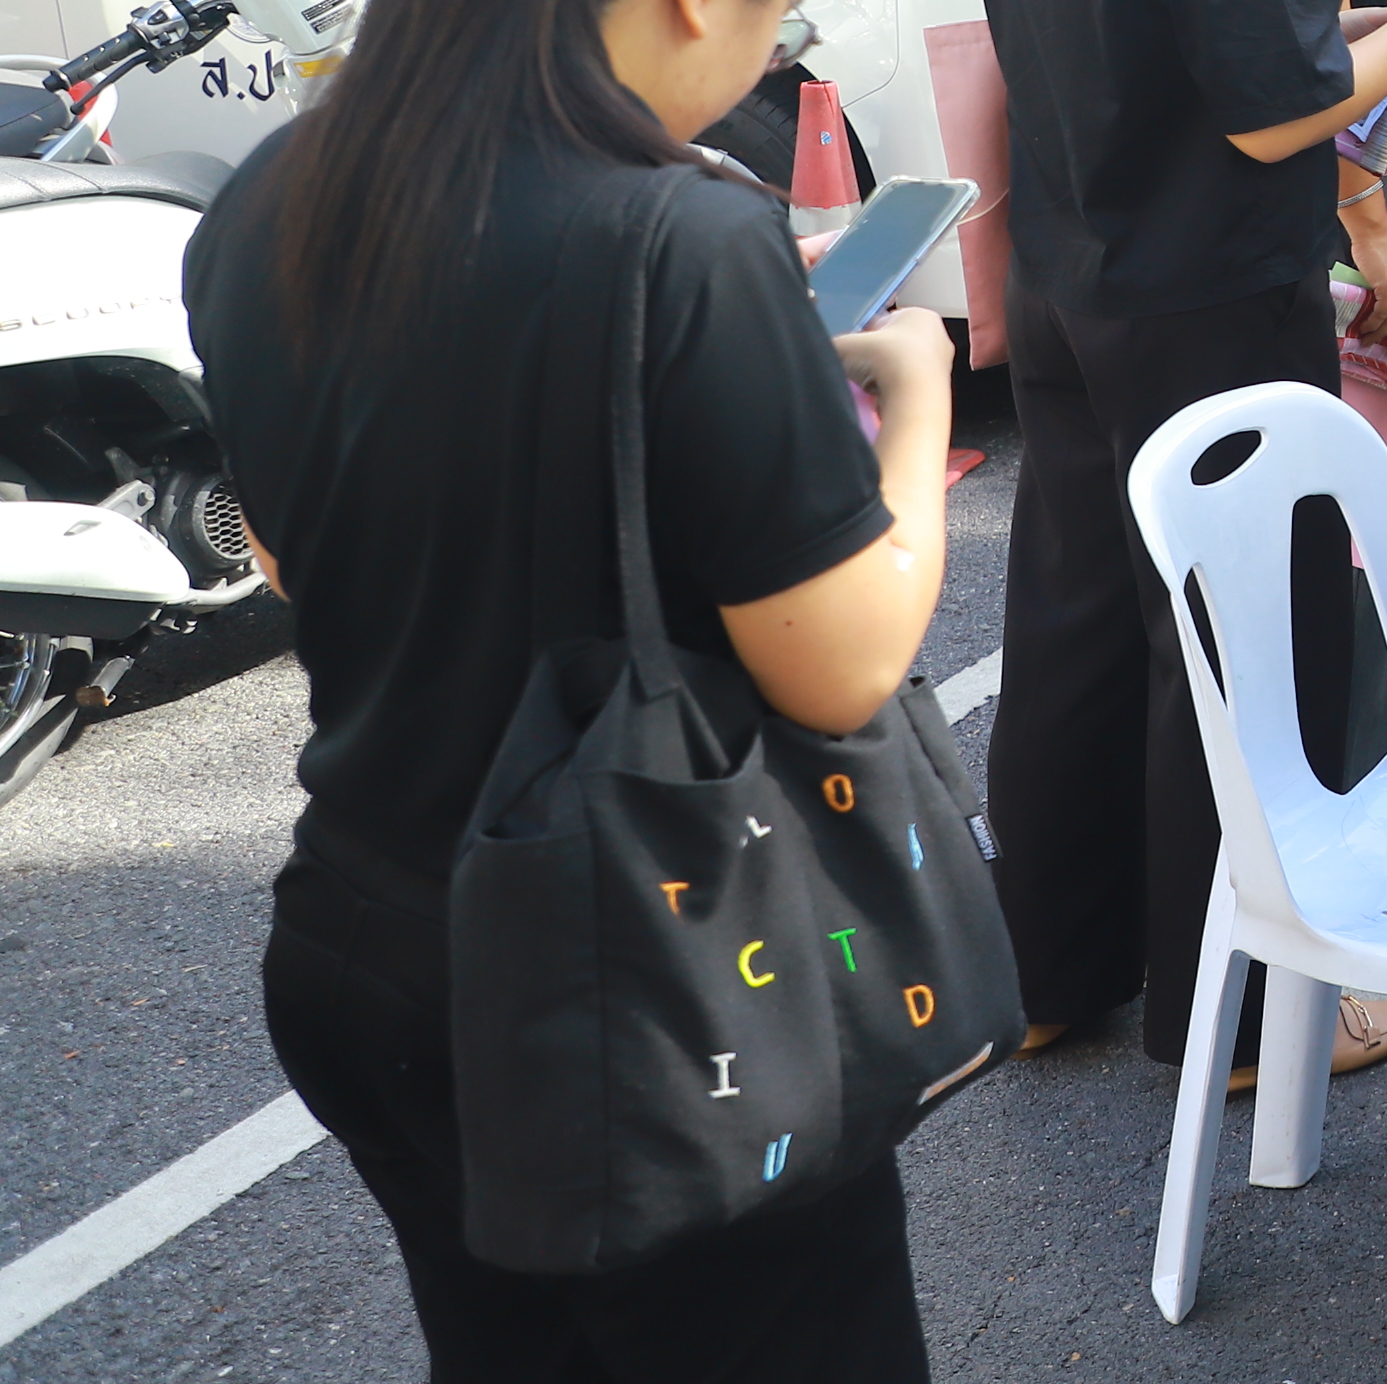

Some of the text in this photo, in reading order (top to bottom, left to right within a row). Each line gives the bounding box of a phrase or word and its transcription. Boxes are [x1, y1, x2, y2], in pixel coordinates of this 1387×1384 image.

[970, 815, 997, 861] FASHION
[737, 939, 776, 989] C
[827, 927, 858, 973] T
[903, 984, 935, 1028] D
[708, 1051, 741, 1099] I
